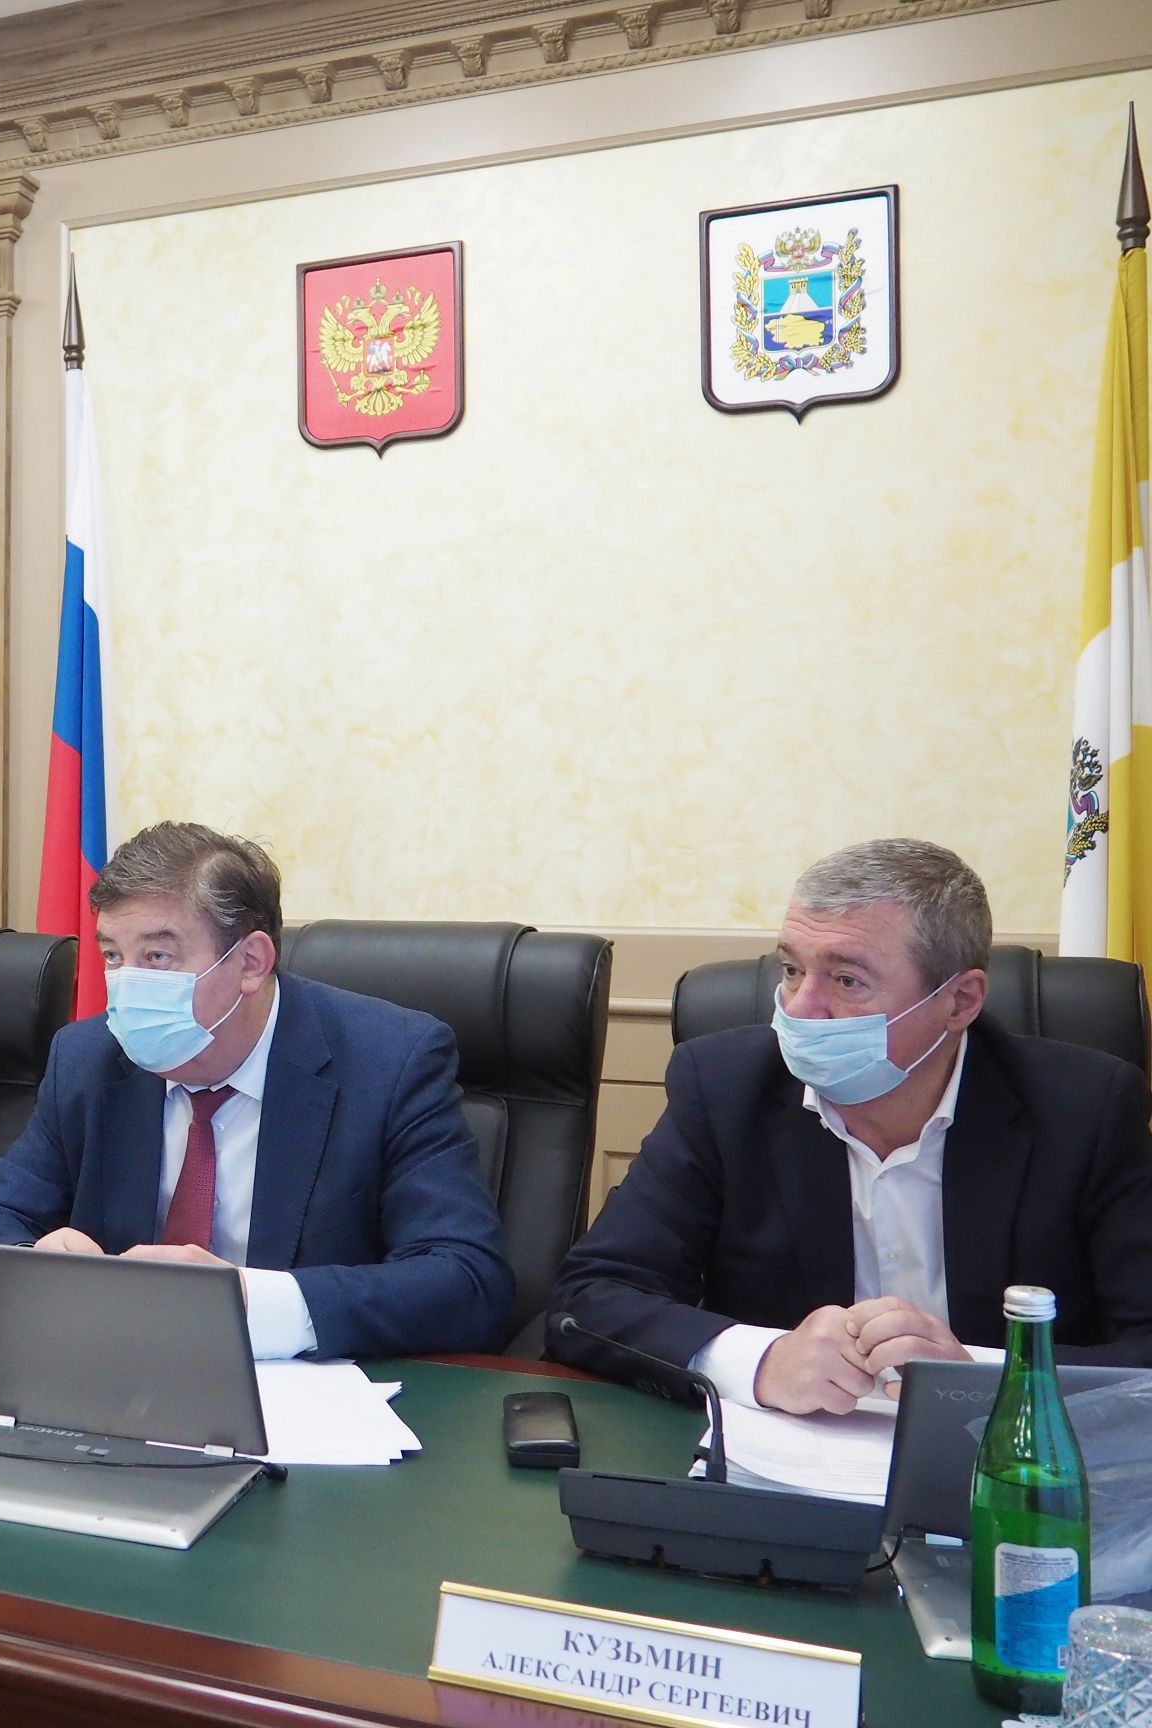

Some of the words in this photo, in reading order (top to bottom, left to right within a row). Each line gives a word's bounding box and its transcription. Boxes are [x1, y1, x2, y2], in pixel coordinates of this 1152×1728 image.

[562, 1629, 724, 1680] КУЗЬМИН
[481, 1650, 642, 1697] АЛЕКСАНДР
[647, 1680, 813, 1728] СЕРГЕЕВИЧ
